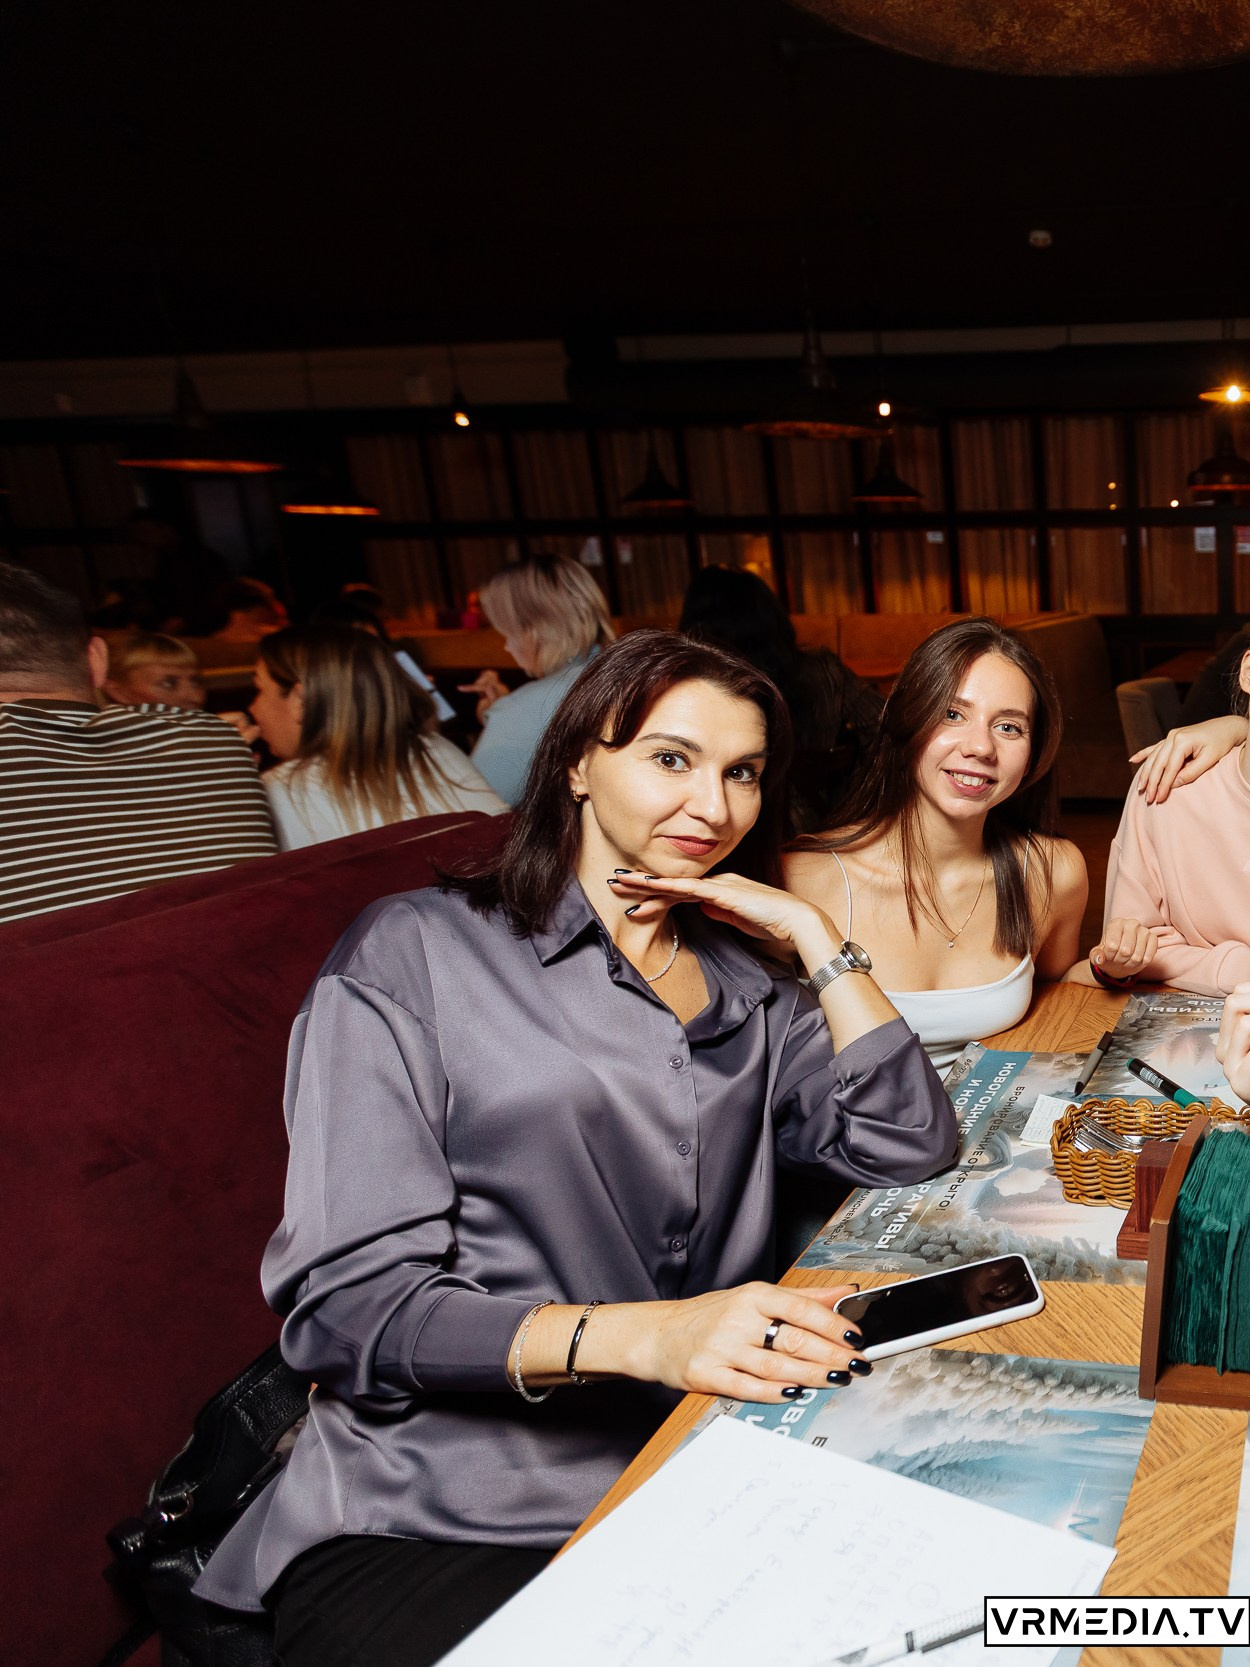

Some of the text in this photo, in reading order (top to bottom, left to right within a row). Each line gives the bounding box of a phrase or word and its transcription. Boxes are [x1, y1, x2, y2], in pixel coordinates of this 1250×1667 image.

[870, 1187, 903, 1217] ОЧЬ
[874, 1062, 1017, 1249] НОВОГОДНИЕ РАТИВЫ
[935, 1086, 1026, 1211] БРОНИРОВАНИЕ ОТКРЫТО!
